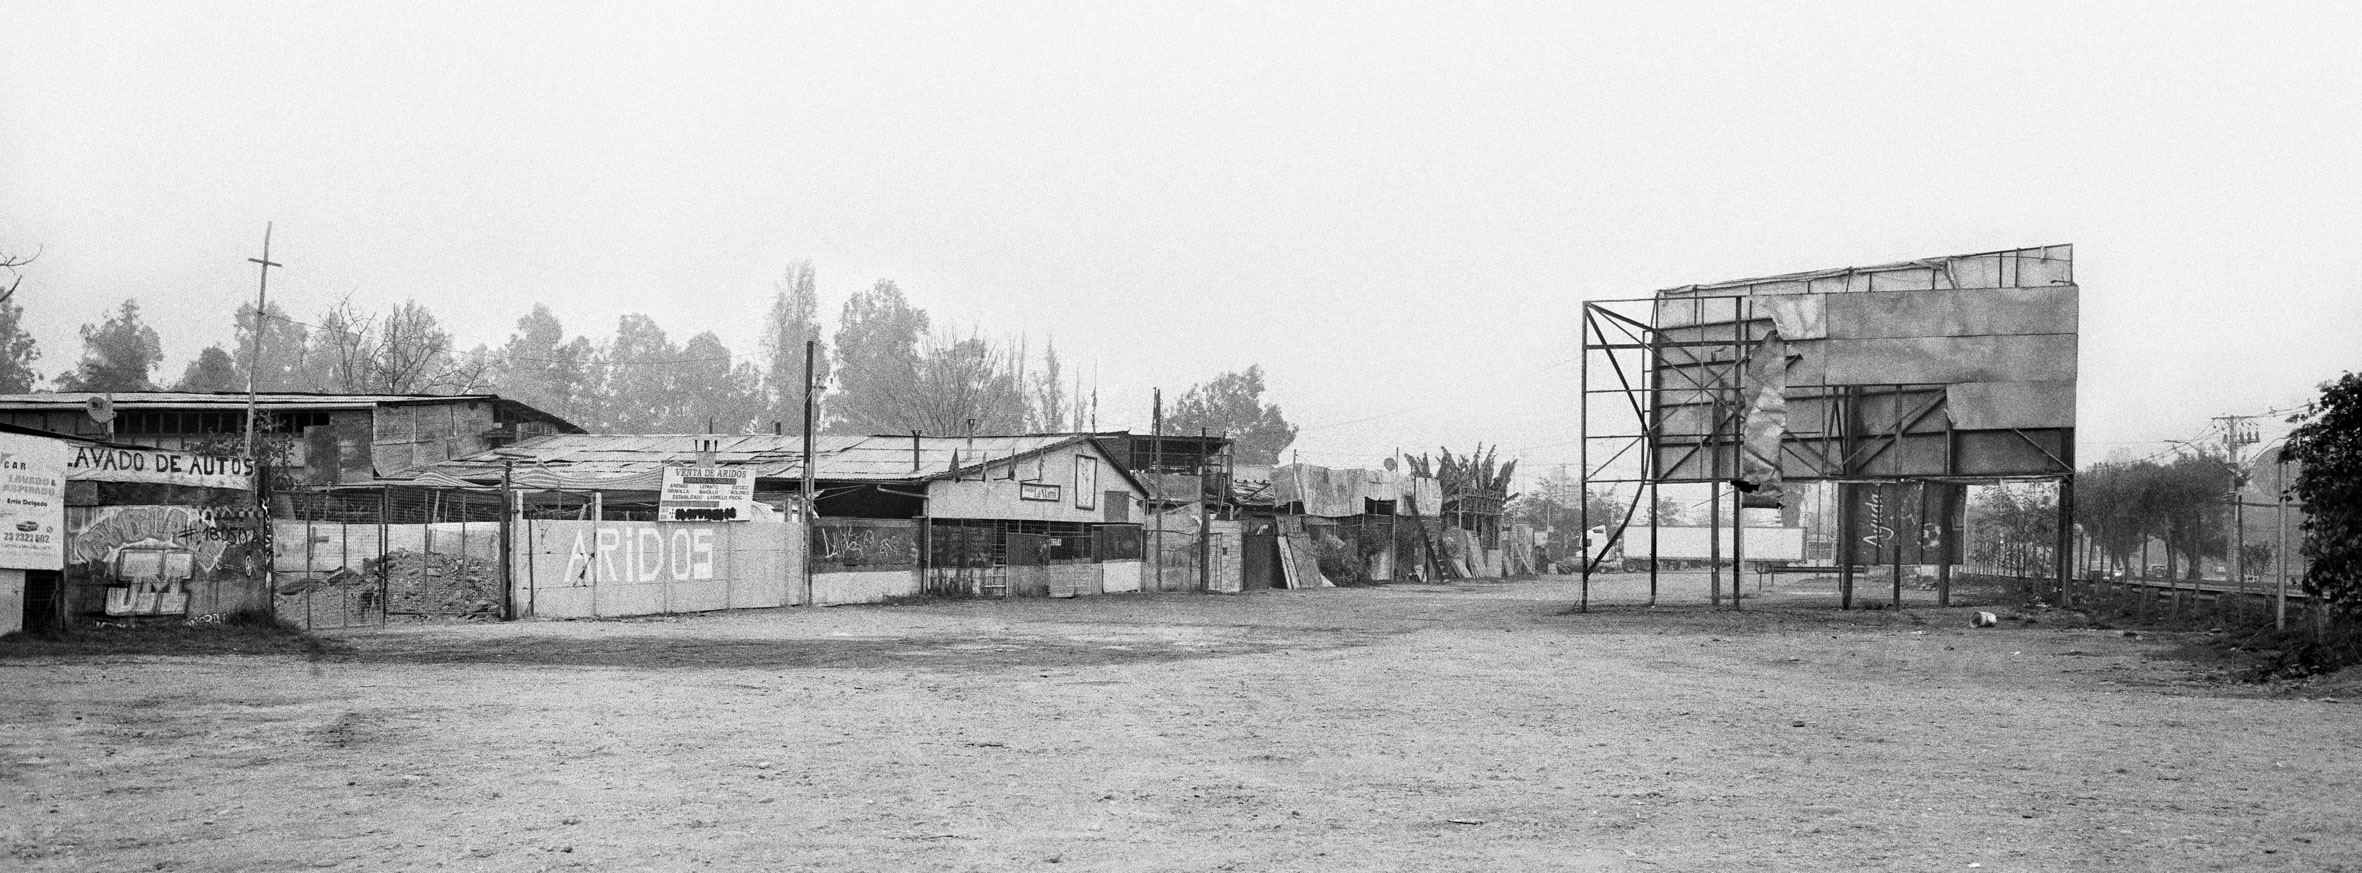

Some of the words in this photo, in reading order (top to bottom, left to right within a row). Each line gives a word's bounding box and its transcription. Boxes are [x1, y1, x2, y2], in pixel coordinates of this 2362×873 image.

[4, 461, 26, 470] CAR
[67, 447, 144, 471] AVADO
[157, 454, 182, 472] DE
[189, 456, 254, 476] AUTOS
[675, 468, 702, 477] VENTA
[704, 468, 715, 477] DE
[717, 469, 747, 478] ARIDOS
[1863, 494, 1894, 548] Ayuda
